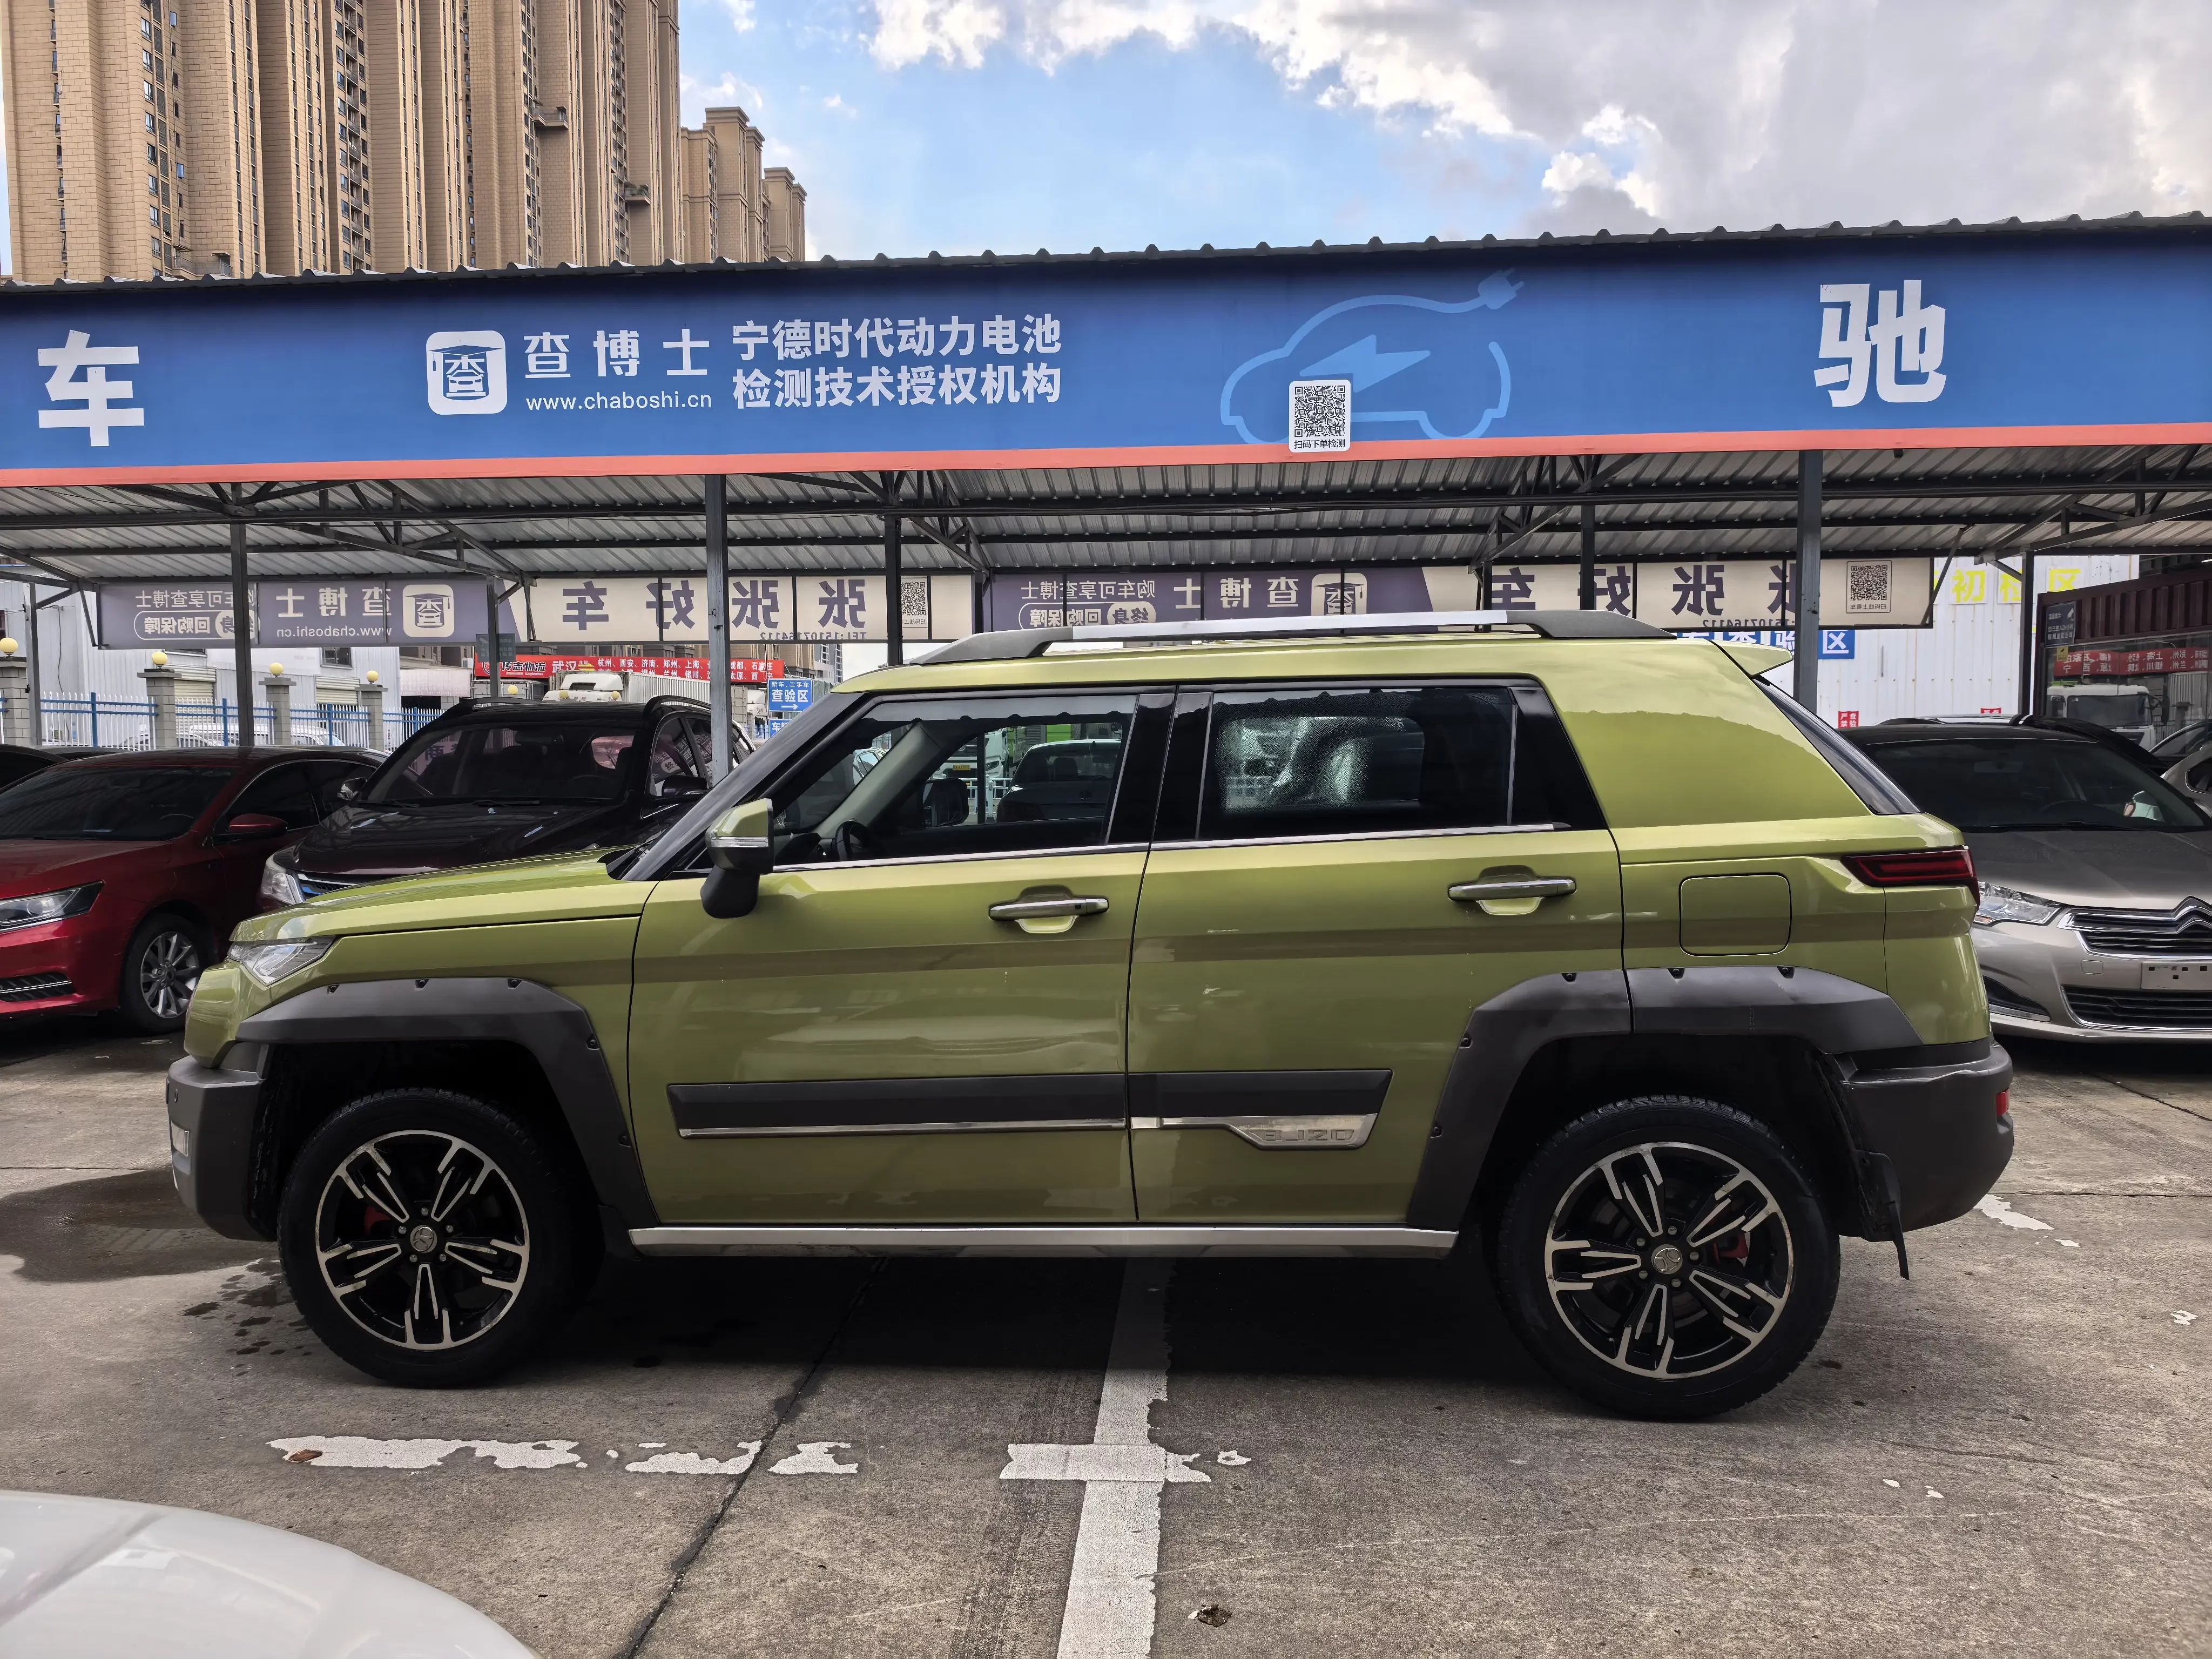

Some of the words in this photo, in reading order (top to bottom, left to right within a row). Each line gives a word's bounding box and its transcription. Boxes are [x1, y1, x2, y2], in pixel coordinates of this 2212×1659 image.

[733, 313, 1061, 360] 宁德时代动力电池
[1813, 280, 1946, 407] 驰
[523, 328, 710, 379] 查博士
[38, 329, 144, 447] 车
[526, 390, 711, 410] www.chaboshi.cn
[733, 362, 1061, 409] 检测技术授权机构
[1294, 439, 1345, 449] 扫码下单检测
[552, 660, 576, 673] 武汉
[598, 658, 710, 669] 杭州、西安、济南、郑州、上海、
[772, 689, 808, 702] 查验区
